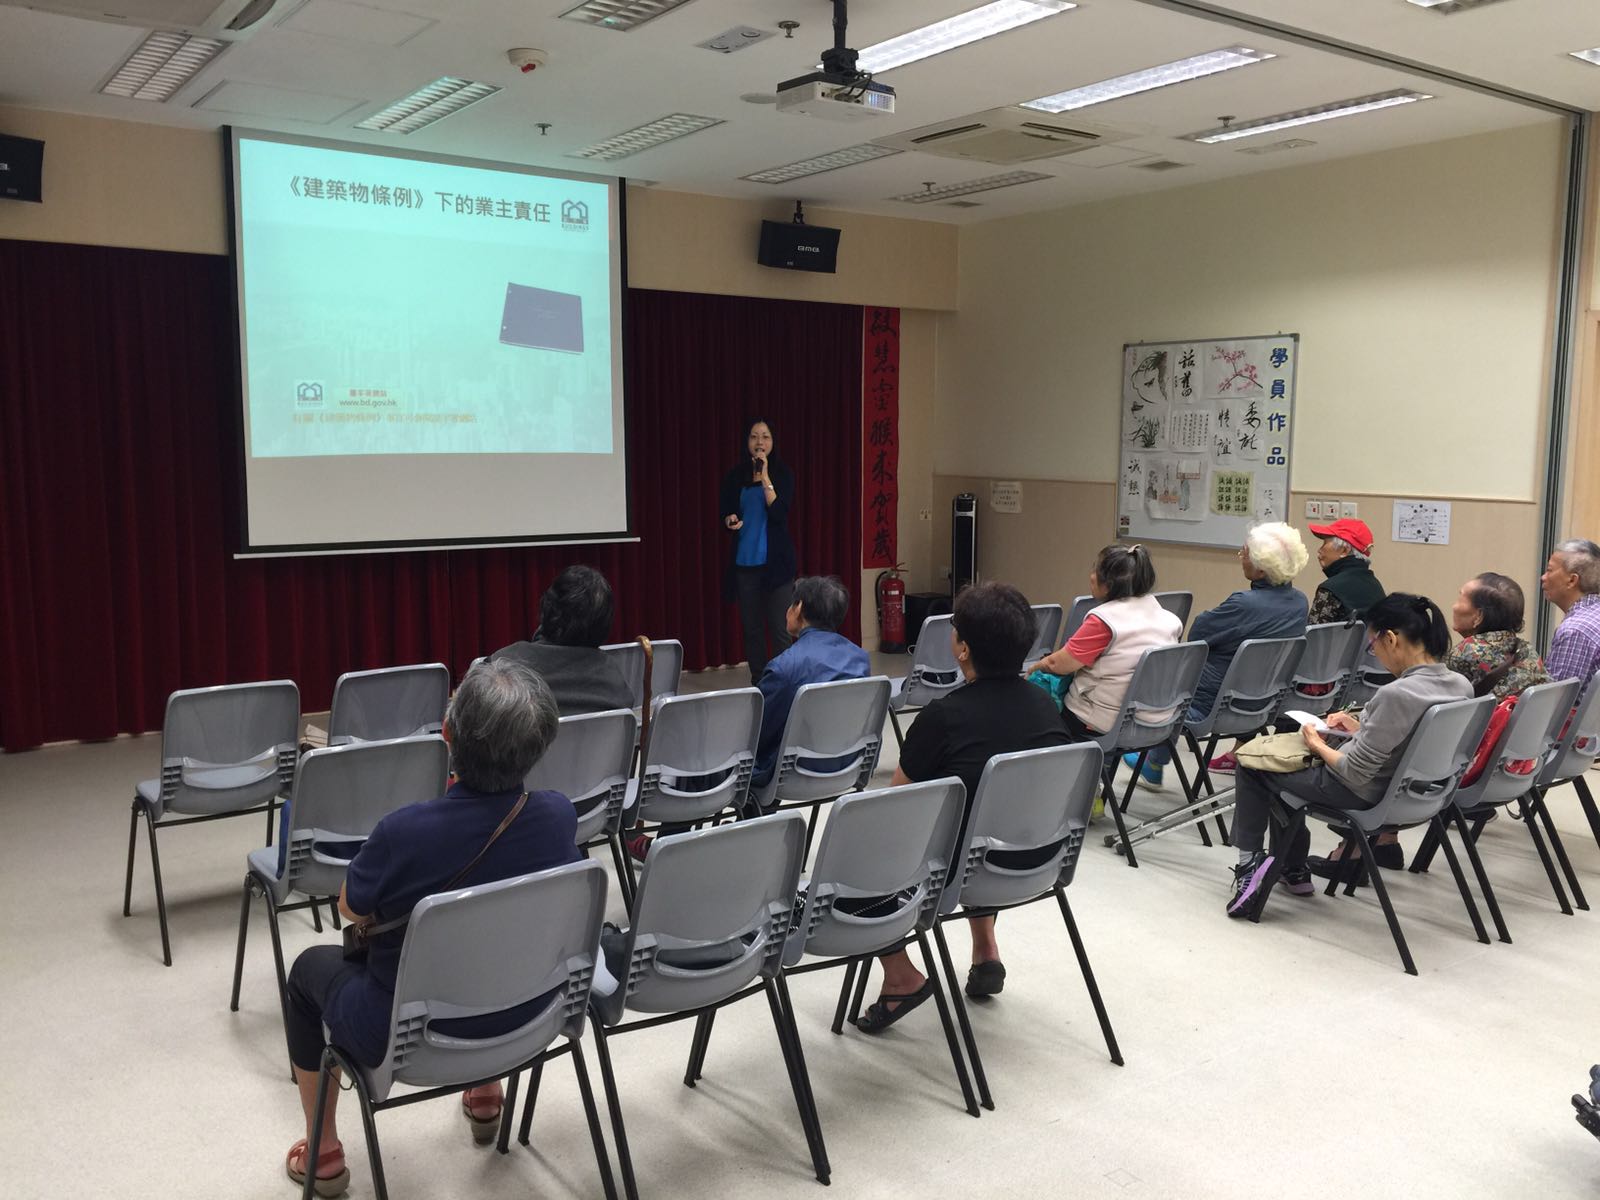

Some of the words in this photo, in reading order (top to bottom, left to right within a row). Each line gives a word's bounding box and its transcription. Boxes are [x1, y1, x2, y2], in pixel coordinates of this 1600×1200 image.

[339, 398, 398, 408] www.bd.gov.hk
[1266, 347, 1289, 466] 學員作品
